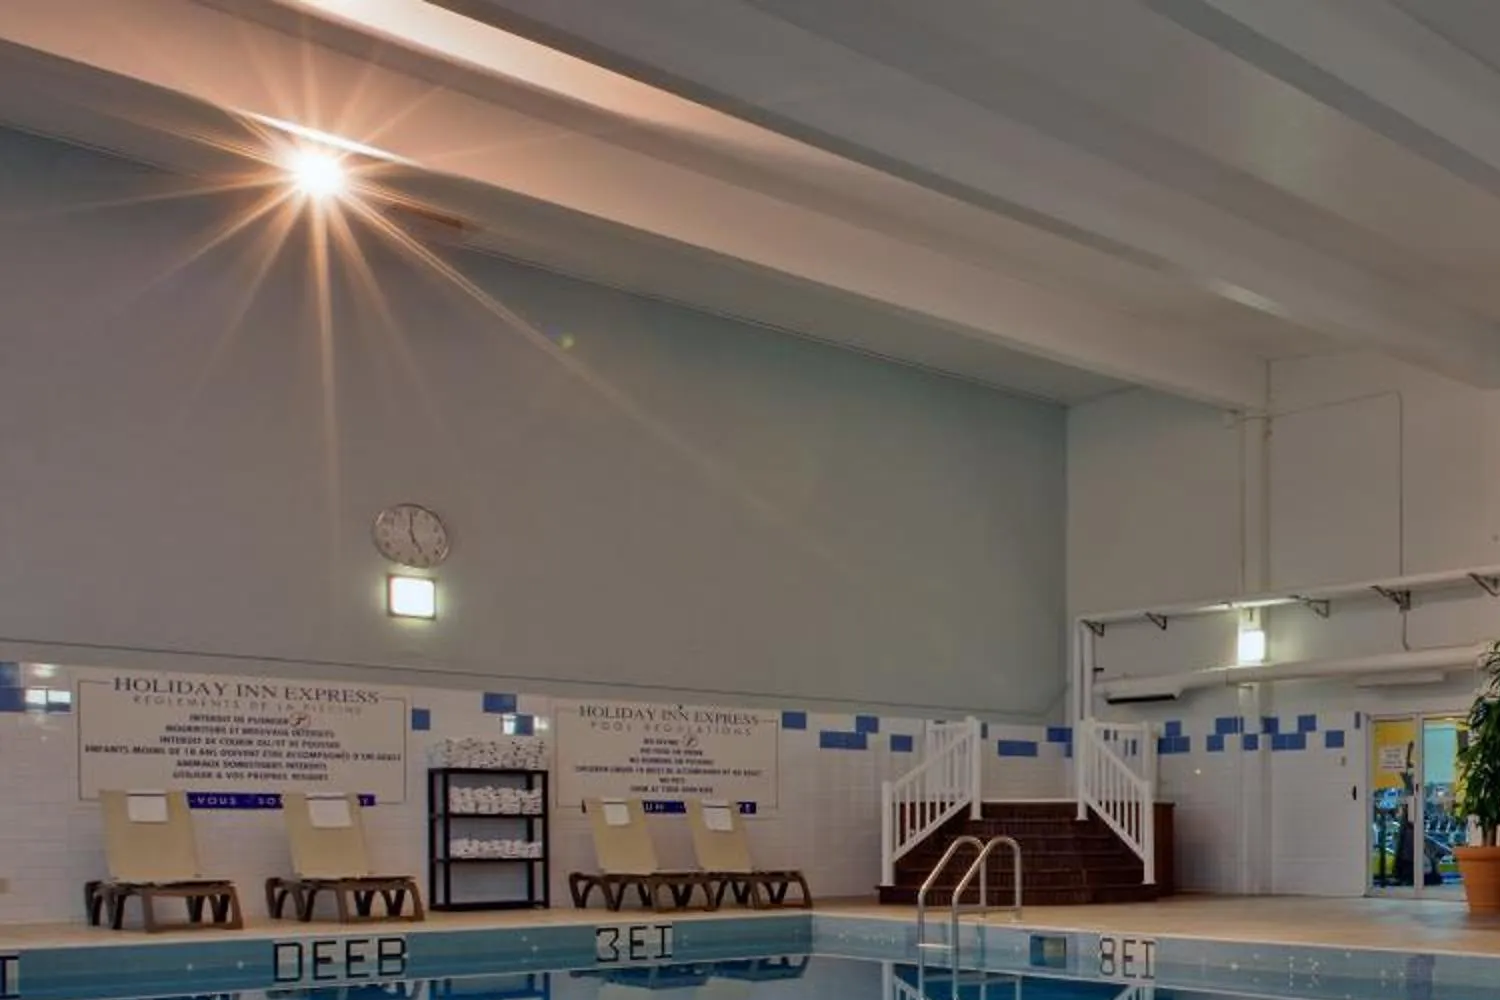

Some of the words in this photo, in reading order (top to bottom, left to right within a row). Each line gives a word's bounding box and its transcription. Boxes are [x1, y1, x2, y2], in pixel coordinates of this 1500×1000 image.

[114, 677, 228, 696] HOLIDAY
[237, 684, 277, 699] INN
[285, 687, 379, 704] EXPRESS
[579, 705, 656, 721] HOLIDAY
[662, 709, 689, 722] INN
[694, 711, 759, 726] EXPRESS
